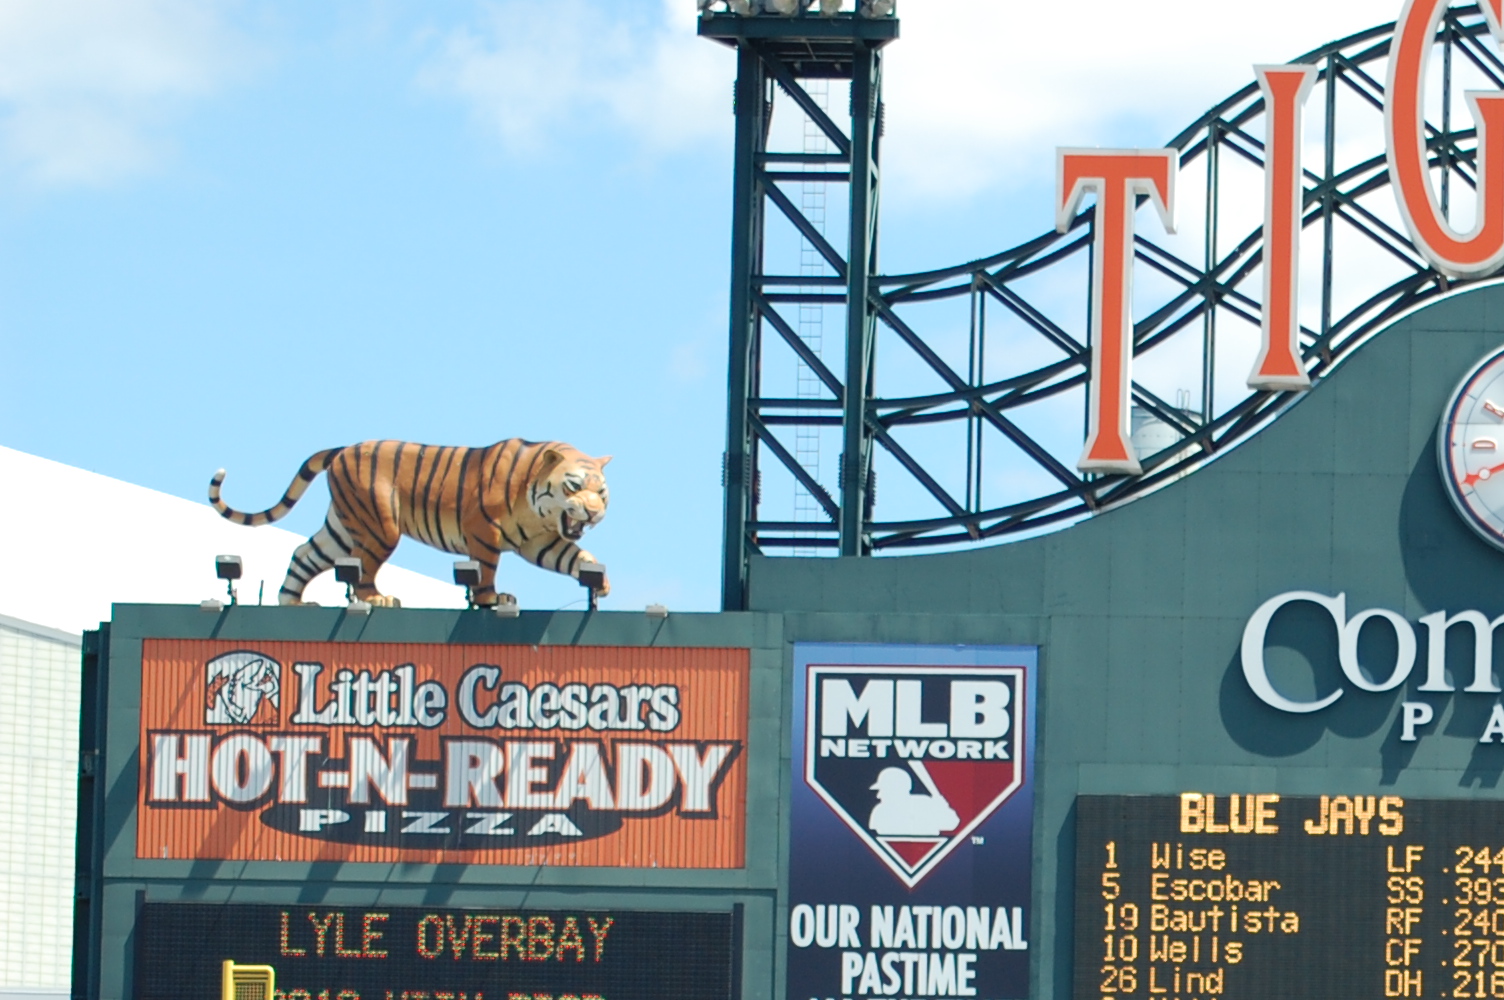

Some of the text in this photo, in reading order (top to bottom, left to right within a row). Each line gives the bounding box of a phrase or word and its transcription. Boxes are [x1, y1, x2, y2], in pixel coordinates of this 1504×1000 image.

[294, 662, 680, 732] Little Caesars
[820, 678, 1011, 738] MLB
[820, 739, 1010, 760] NETWORK
[147, 732, 736, 814] HOT-N-READY
[299, 808, 584, 836] PIZZA
[1180, 792, 1404, 835] BLUE JAYS
[1151, 842, 1226, 871] Wise
[1386, 845, 1424, 874] LF
[1151, 873, 1281, 903] Escobar
[1386, 877, 1424, 904] SS
[279, 911, 614, 961] LYLE OVERBAY
[790, 903, 1027, 950] OUR NATIONAL
[1150, 905, 1300, 934] Bautista
[1386, 908, 1423, 935] RF
[1149, 936, 1243, 964] Wells
[1386, 939, 1422, 967] CF
[841, 951, 977, 997] PASTIME
[1149, 968, 1224, 995] Lind
[1385, 971, 1422, 998] DH
